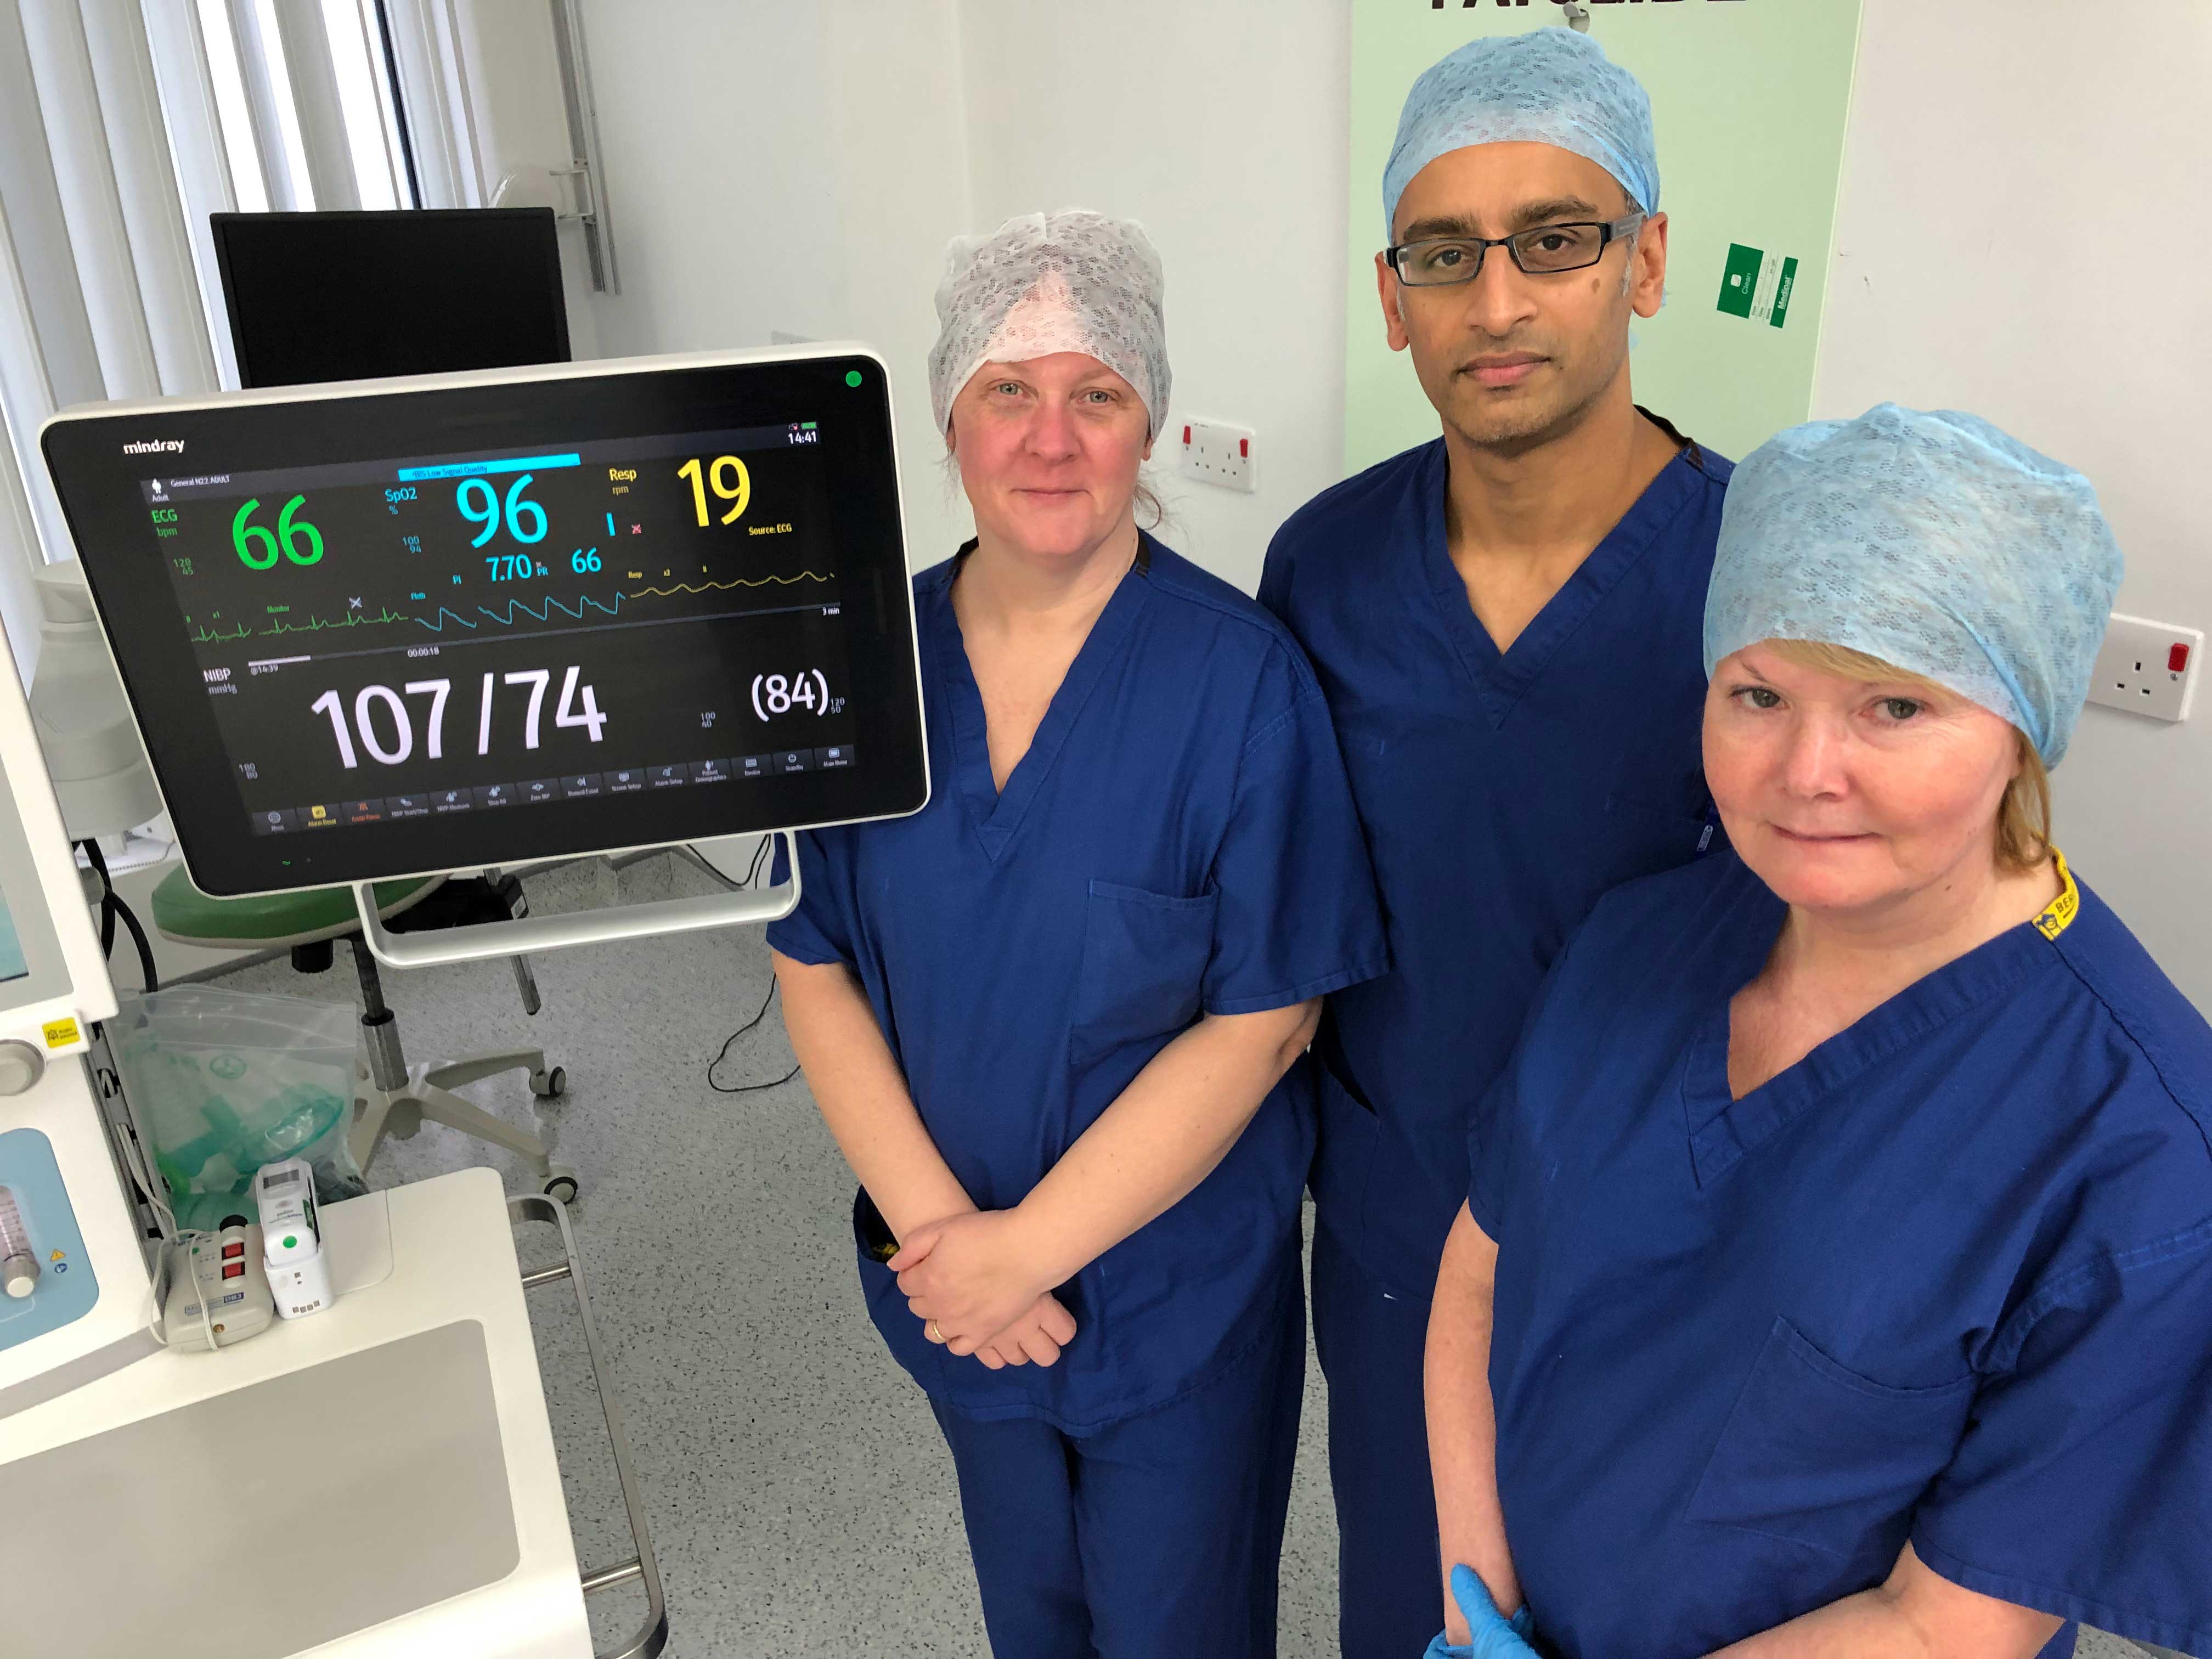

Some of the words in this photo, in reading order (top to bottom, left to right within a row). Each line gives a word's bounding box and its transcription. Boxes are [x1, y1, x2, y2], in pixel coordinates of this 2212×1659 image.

[1741, 273, 1752, 295] Clean
[788, 430, 817, 444] 14:41
[123, 439, 184, 454] mindray
[442, 467, 463, 477] Signal
[464, 465, 488, 474] Quality
[609, 468, 637, 482] Resp
[171, 477, 195, 487] General
[210, 475, 230, 483] ADULT
[612, 486, 629, 495] rpm
[677, 455, 751, 527] 19
[152, 494, 169, 502] Adult
[151, 509, 178, 523] ECG
[388, 505, 399, 515] %
[456, 474, 548, 549] 96
[156, 527, 178, 538] bpm
[233, 494, 324, 570] 66
[777, 523, 792, 533] ECG
[402, 535, 420, 546] 100
[410, 545, 422, 554] 94
[173, 557, 191, 568] 120
[572, 546, 602, 574] 66
[182, 567, 194, 575] 45
[486, 554, 532, 582] 7.70
[537, 566, 549, 577] PR
[203, 667, 231, 682] NIBP
[208, 683, 238, 695] mmHg
[752, 668, 829, 722] (84)
